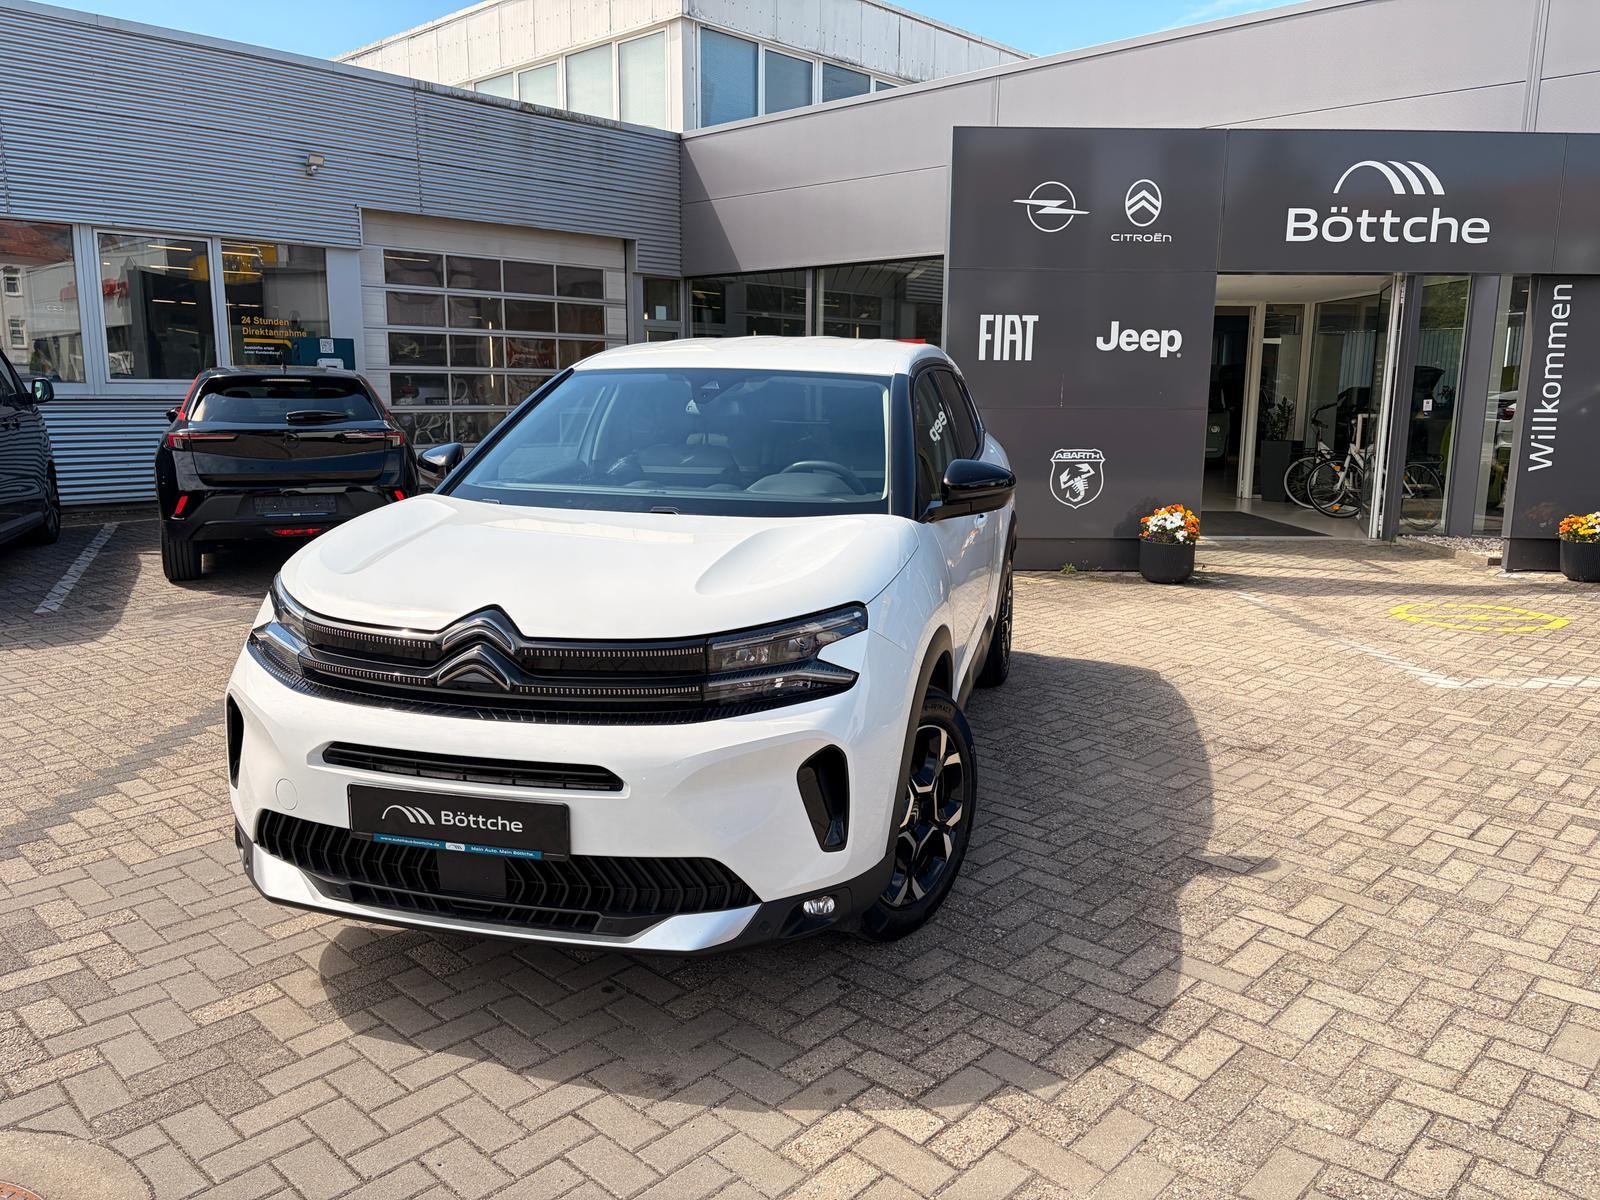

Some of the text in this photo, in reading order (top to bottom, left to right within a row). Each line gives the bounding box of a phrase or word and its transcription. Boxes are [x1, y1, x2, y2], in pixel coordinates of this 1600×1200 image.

[1285, 206, 1491, 245] Böttche
[241, 315, 289, 326] 24 Stunden
[242, 327, 307, 338] Direktannahme
[978, 314, 1039, 361] FIAT
[1096, 320, 1183, 358] Jeep
[1528, 283, 1573, 472] Willkommen
[1055, 451, 1101, 460] ABARTH
[440, 810, 524, 833] Böttche
